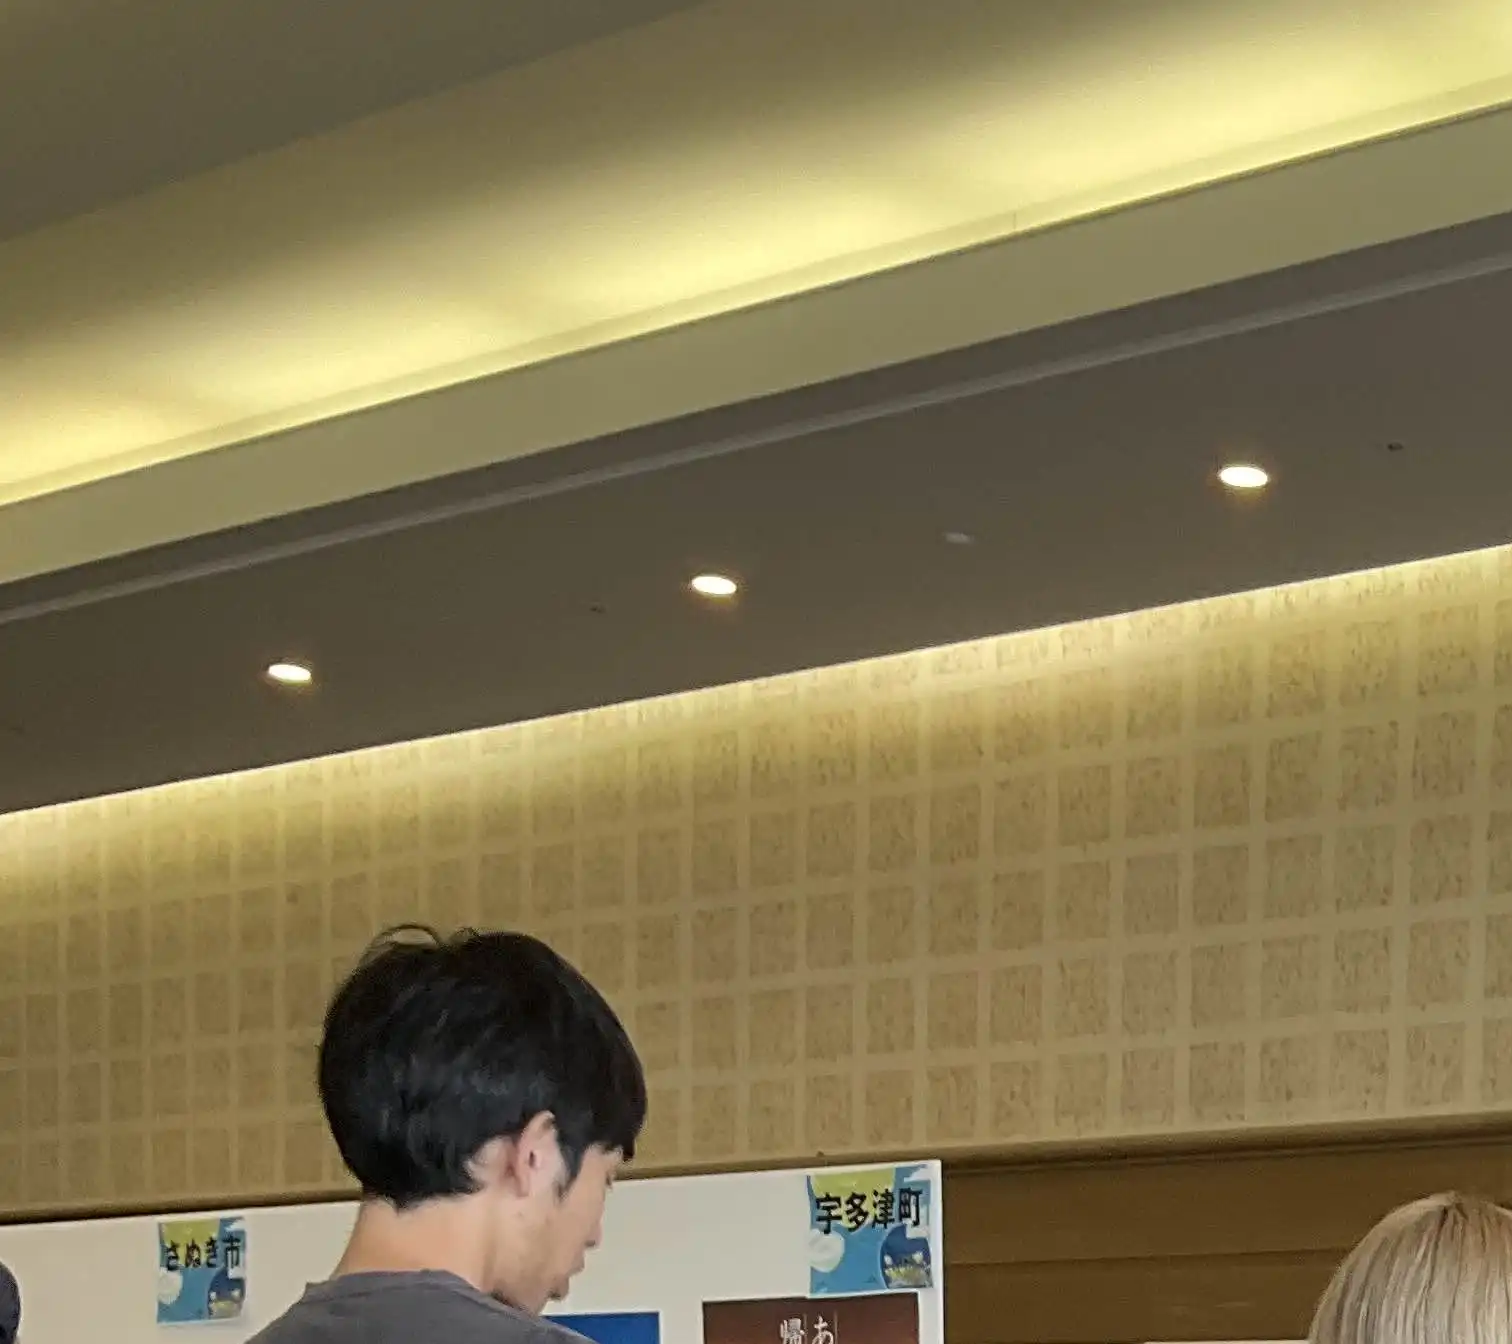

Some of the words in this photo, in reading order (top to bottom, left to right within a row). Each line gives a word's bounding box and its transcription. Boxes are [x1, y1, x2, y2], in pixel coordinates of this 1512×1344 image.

[815, 1187, 922, 1234] 宇多津町
[166, 1234, 242, 1271] さぬき市
